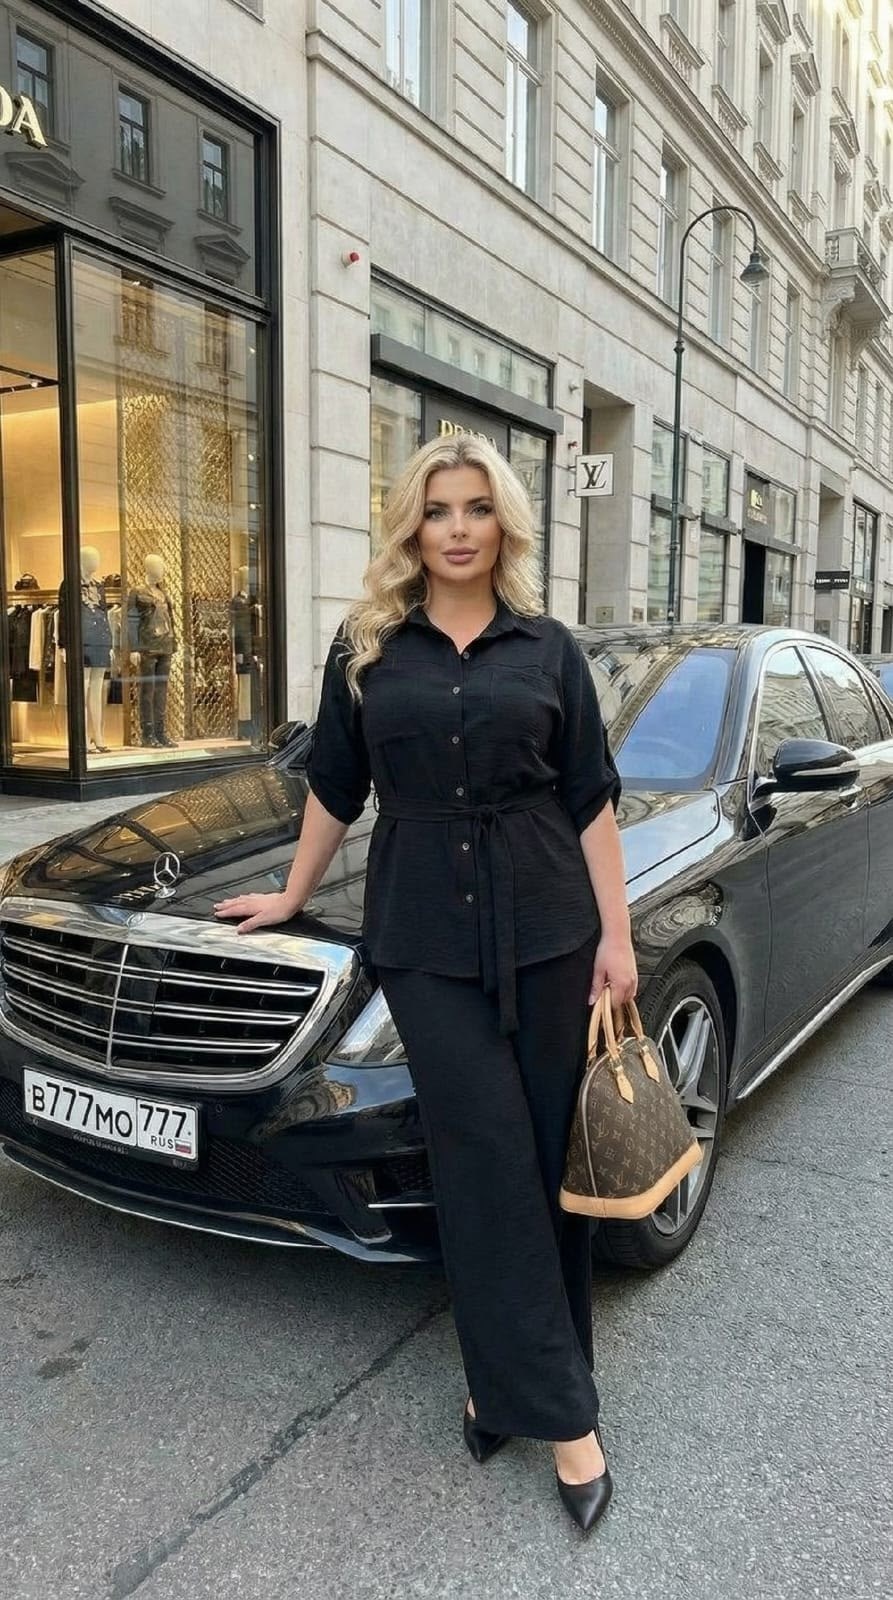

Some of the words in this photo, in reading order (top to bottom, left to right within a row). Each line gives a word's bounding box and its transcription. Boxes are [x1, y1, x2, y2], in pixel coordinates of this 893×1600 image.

[580, 460, 608, 490] LV
[140, 1104, 187, 1138] 777
[150, 1135, 174, 1149] RUS
